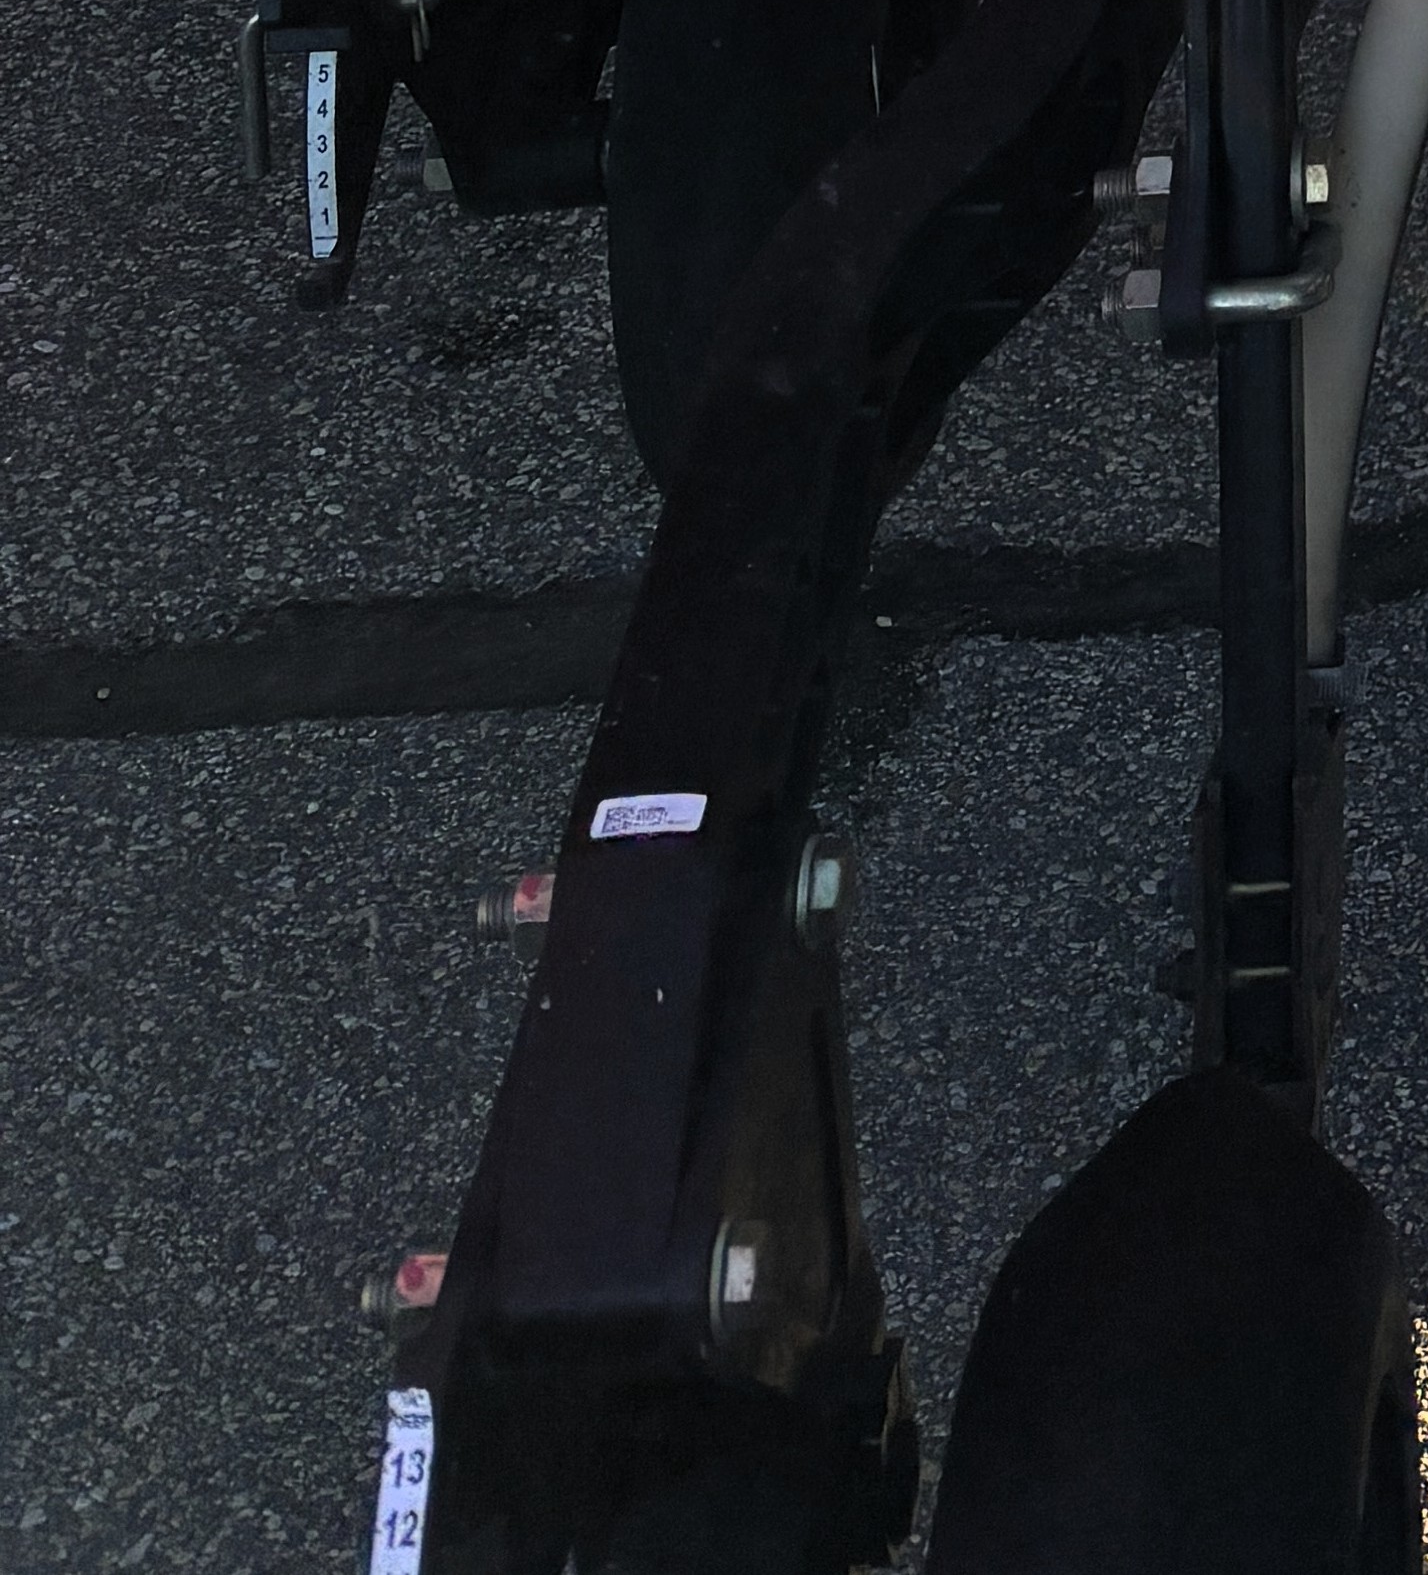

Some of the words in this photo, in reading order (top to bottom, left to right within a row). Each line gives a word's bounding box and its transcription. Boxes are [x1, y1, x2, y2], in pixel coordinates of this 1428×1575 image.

[318, 64, 331, 83] 5
[317, 99, 328, 118] 4
[317, 134, 328, 153] 3
[318, 171, 329, 189] 2
[321, 207, 329, 226] 1
[391, 1450, 426, 1488] 13
[384, 1509, 418, 1549] 12
